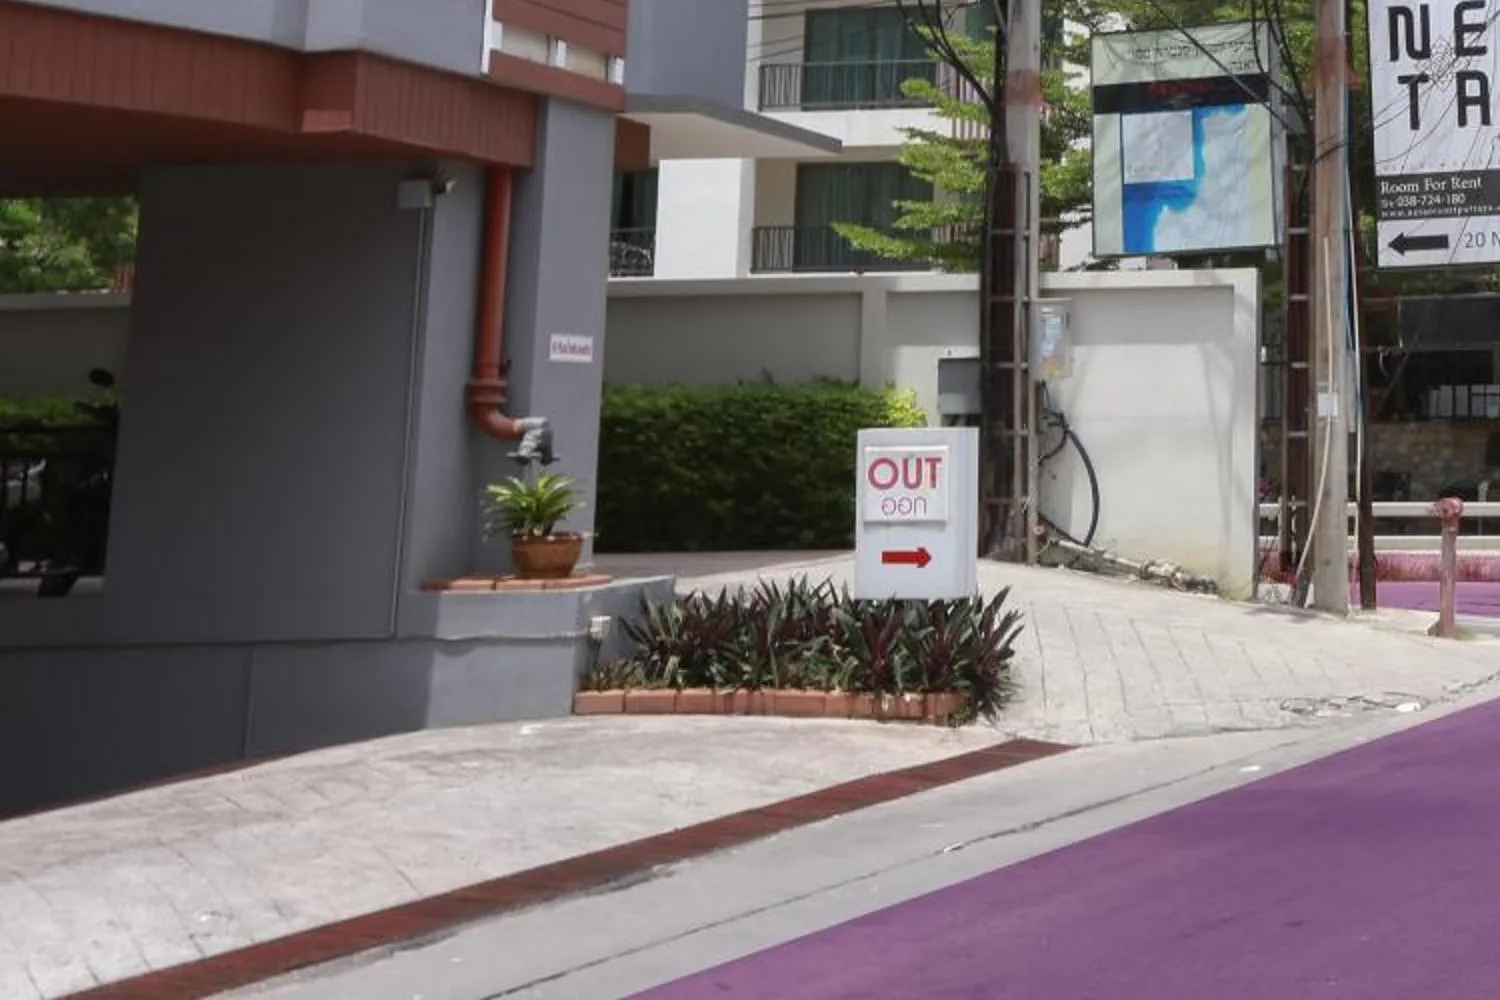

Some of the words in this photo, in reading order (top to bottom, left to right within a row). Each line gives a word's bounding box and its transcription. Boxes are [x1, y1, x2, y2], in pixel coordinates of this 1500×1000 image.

[1380, 180, 1420, 195] Room
[1424, 176, 1447, 191] For
[1450, 175, 1482, 190] Rent
[1463, 231, 1487, 250] 20
[867, 456, 943, 491] OUT
[881, 495, 928, 516] ออก
